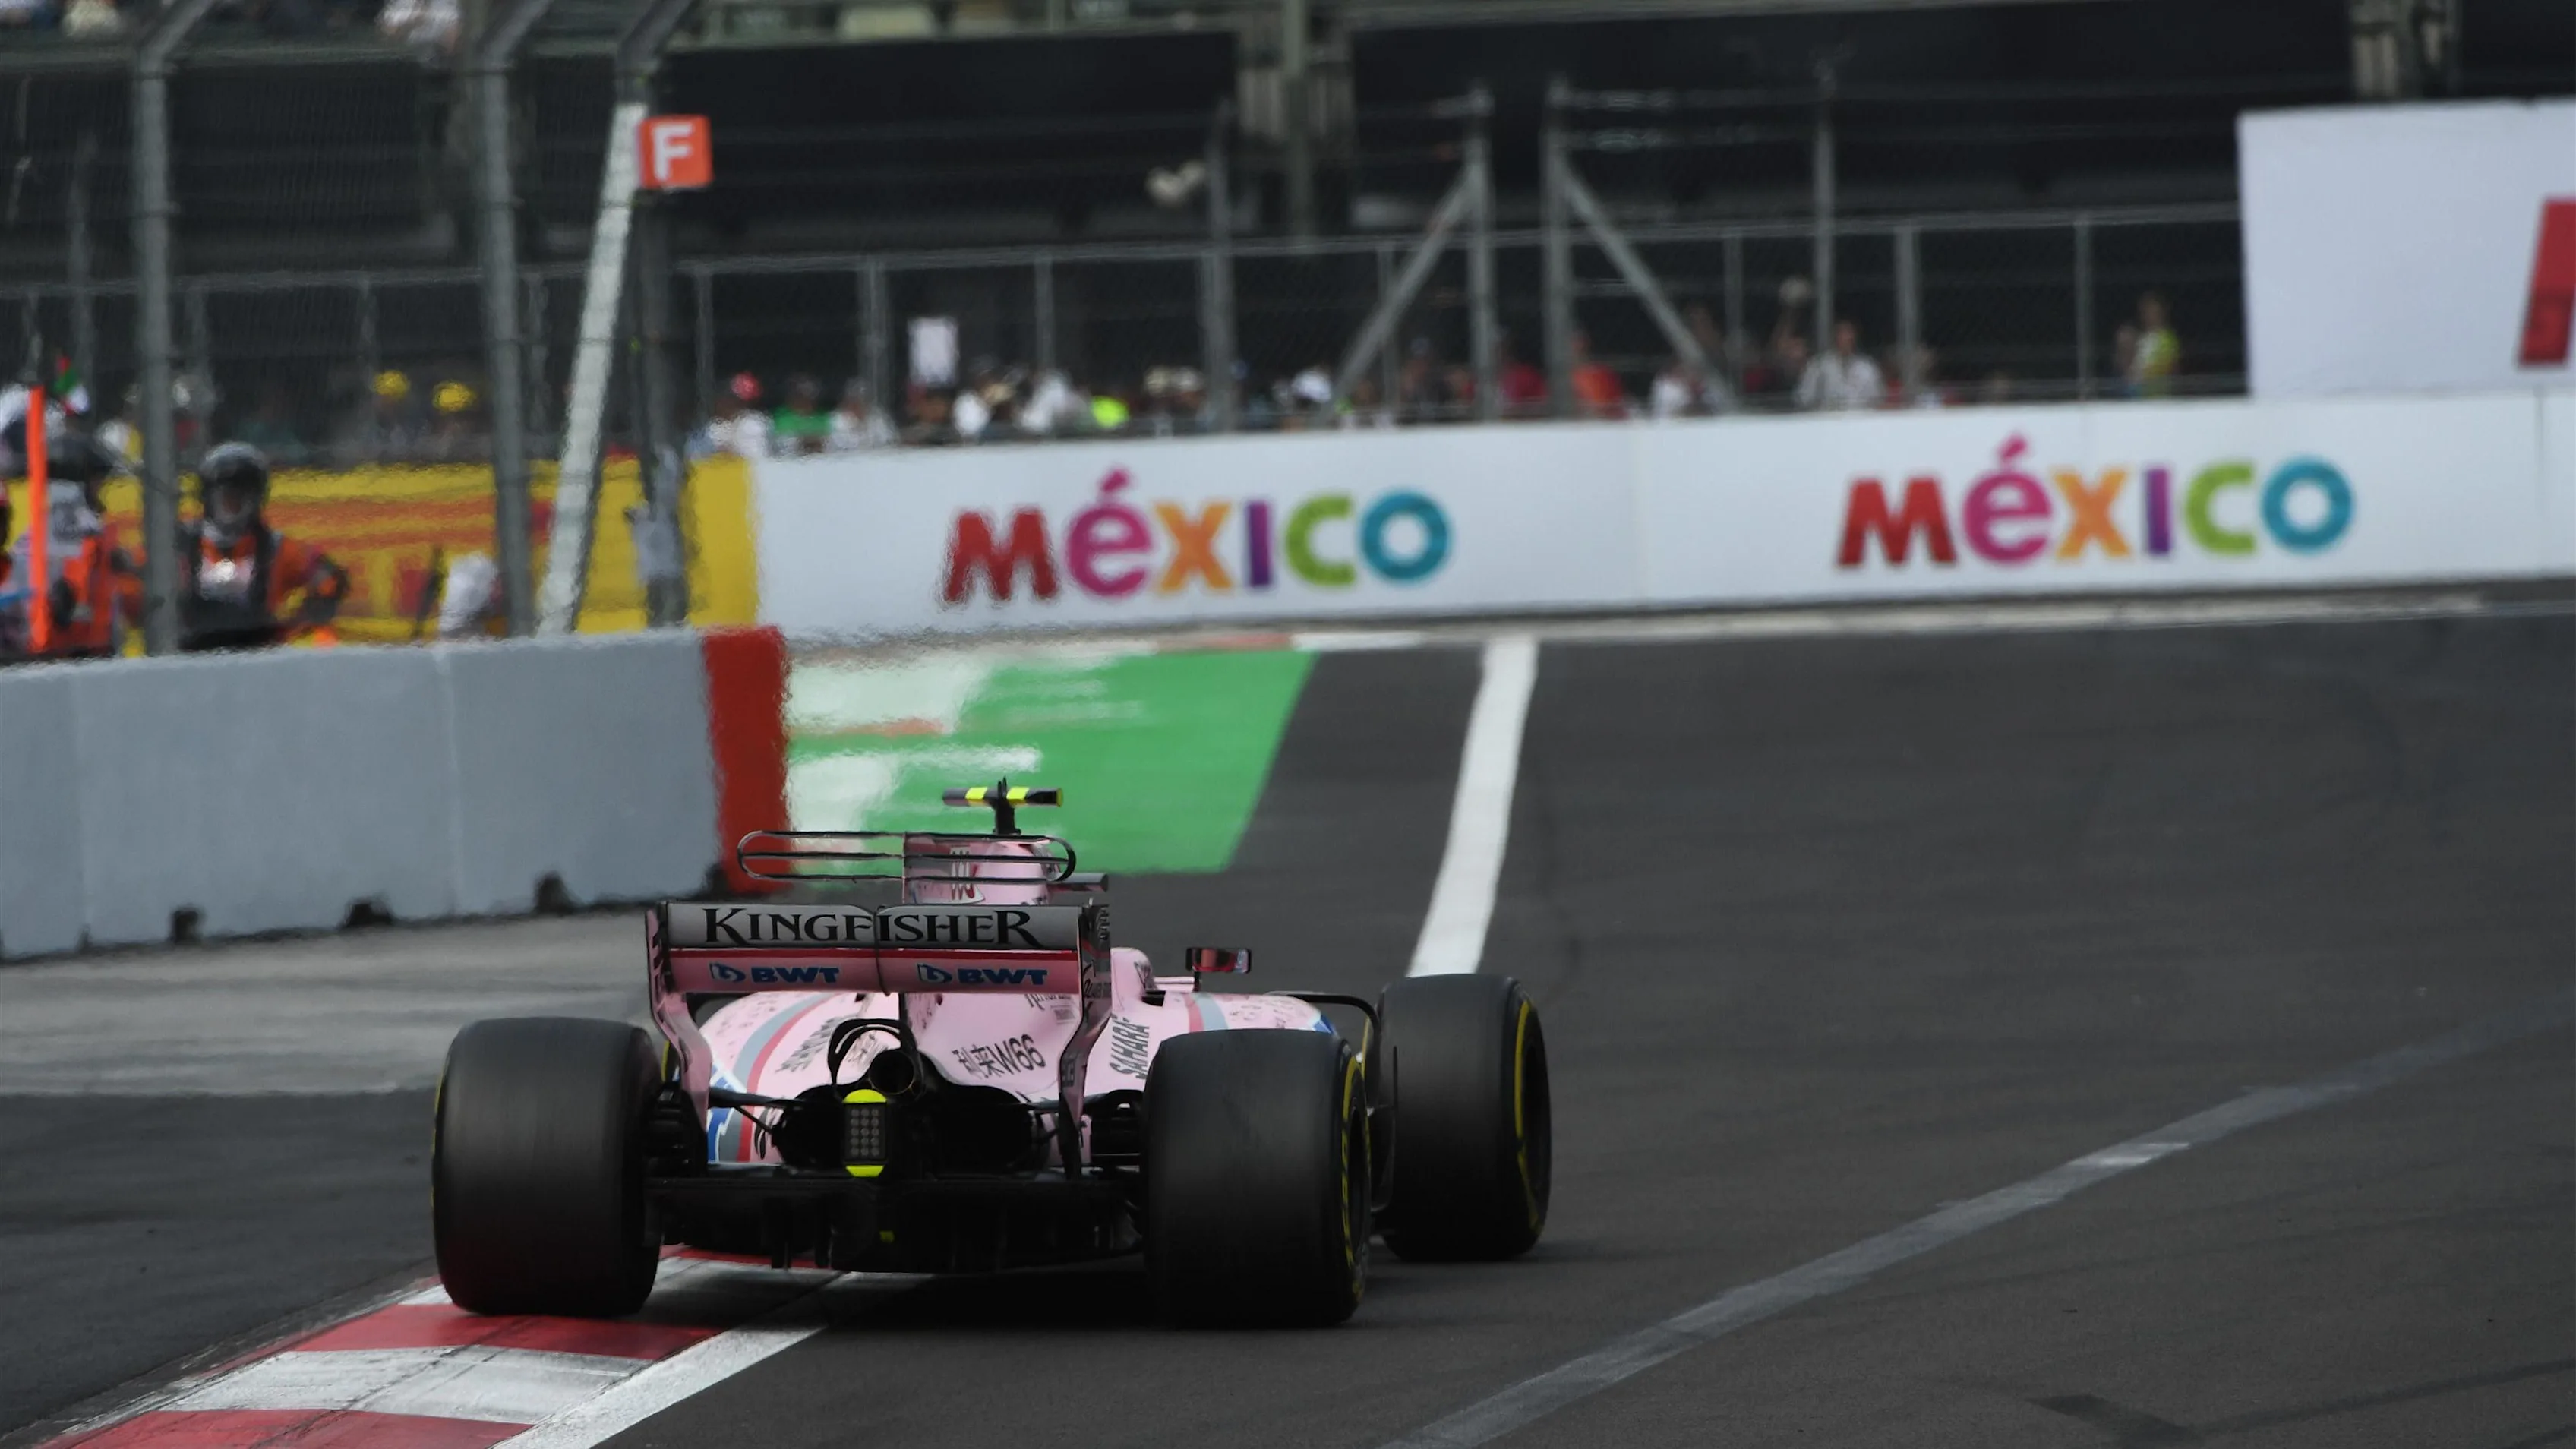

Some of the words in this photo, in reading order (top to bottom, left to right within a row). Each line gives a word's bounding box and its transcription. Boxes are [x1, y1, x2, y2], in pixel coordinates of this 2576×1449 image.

[653, 124, 693, 182] F
[702, 908, 1045, 948] KINGFISHER
[750, 967, 839, 983] BWT
[957, 968, 1048, 986] BWT
